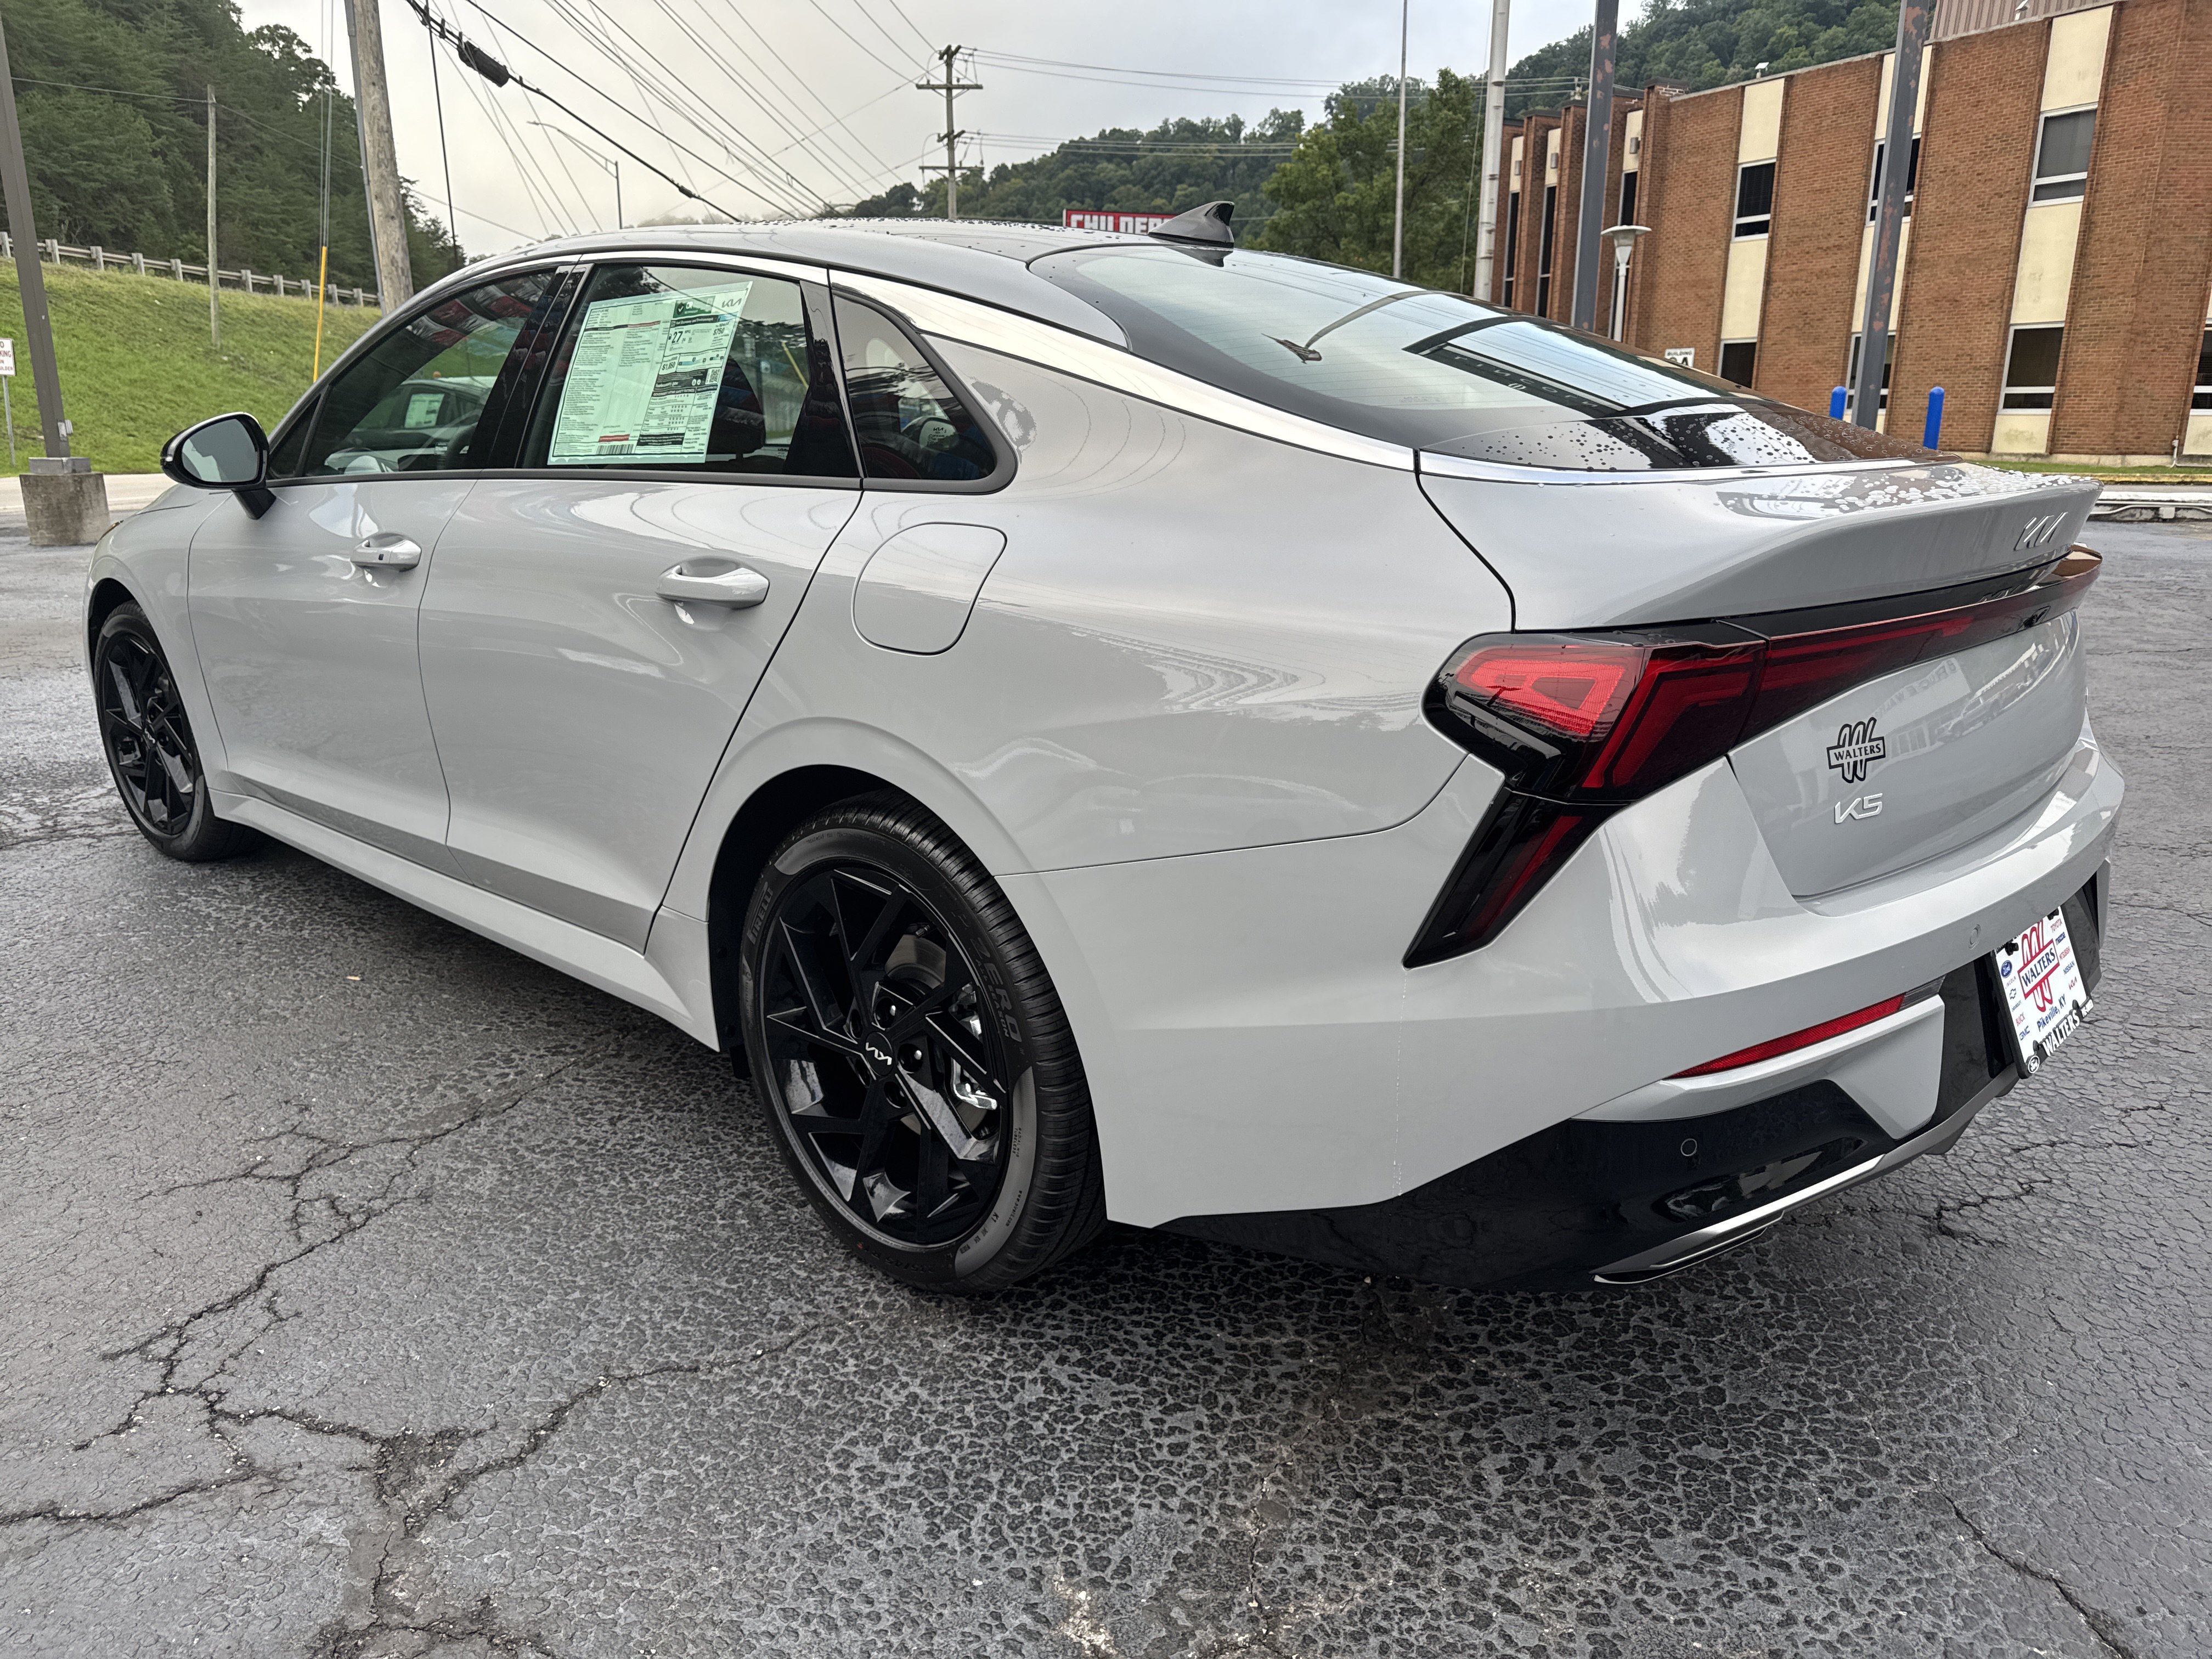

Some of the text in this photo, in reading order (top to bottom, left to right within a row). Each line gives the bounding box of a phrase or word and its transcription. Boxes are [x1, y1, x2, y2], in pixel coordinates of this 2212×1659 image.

[672, 331, 684, 344] 27
[1833, 743, 1882, 761] WALTERS
[1835, 793, 1883, 824] K5
[2021, 947, 2056, 988] WALTERS
[2058, 994, 2067, 1009] KY
[2019, 1025, 2030, 1041] GMC
[2042, 1009, 2080, 1057] WALTERS
